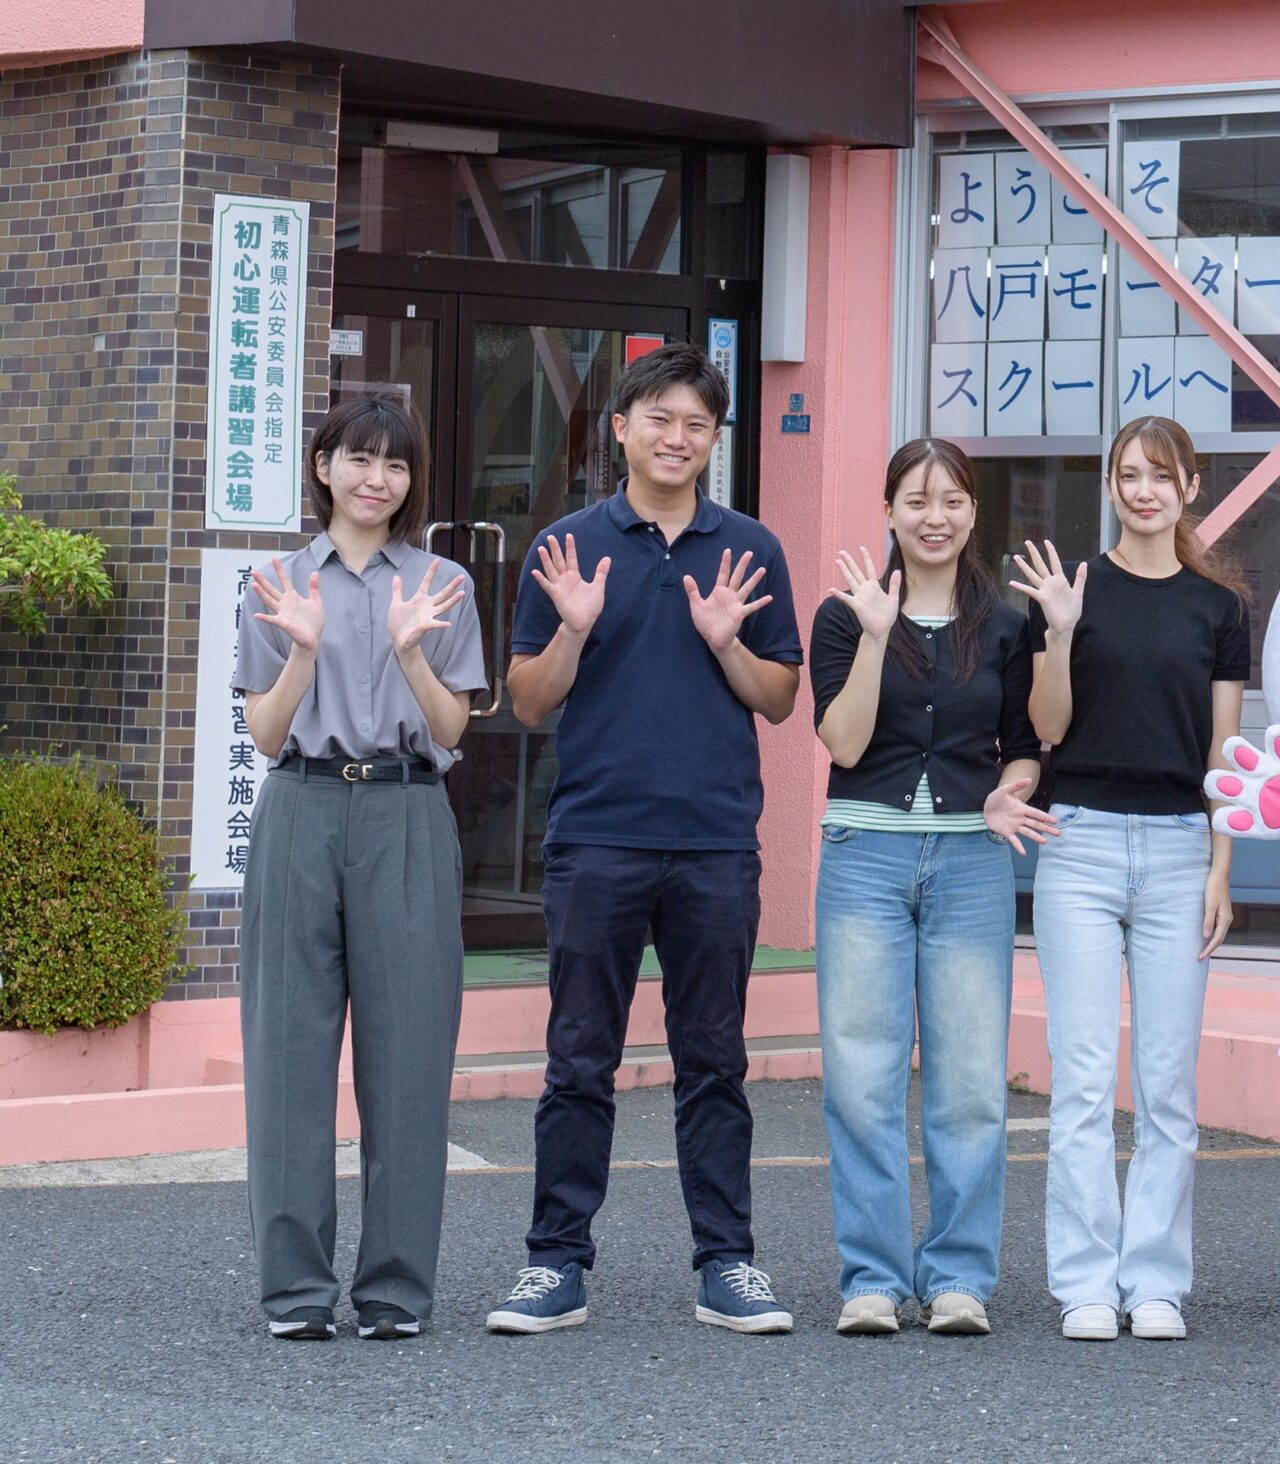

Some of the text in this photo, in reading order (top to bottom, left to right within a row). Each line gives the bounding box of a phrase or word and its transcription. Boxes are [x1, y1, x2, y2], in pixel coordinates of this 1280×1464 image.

[225, 220, 262, 512] 初心運転者講習会場
[264, 214, 290, 464] 青森県公安委員会指定
[937, 360, 1229, 412] スクールへ
